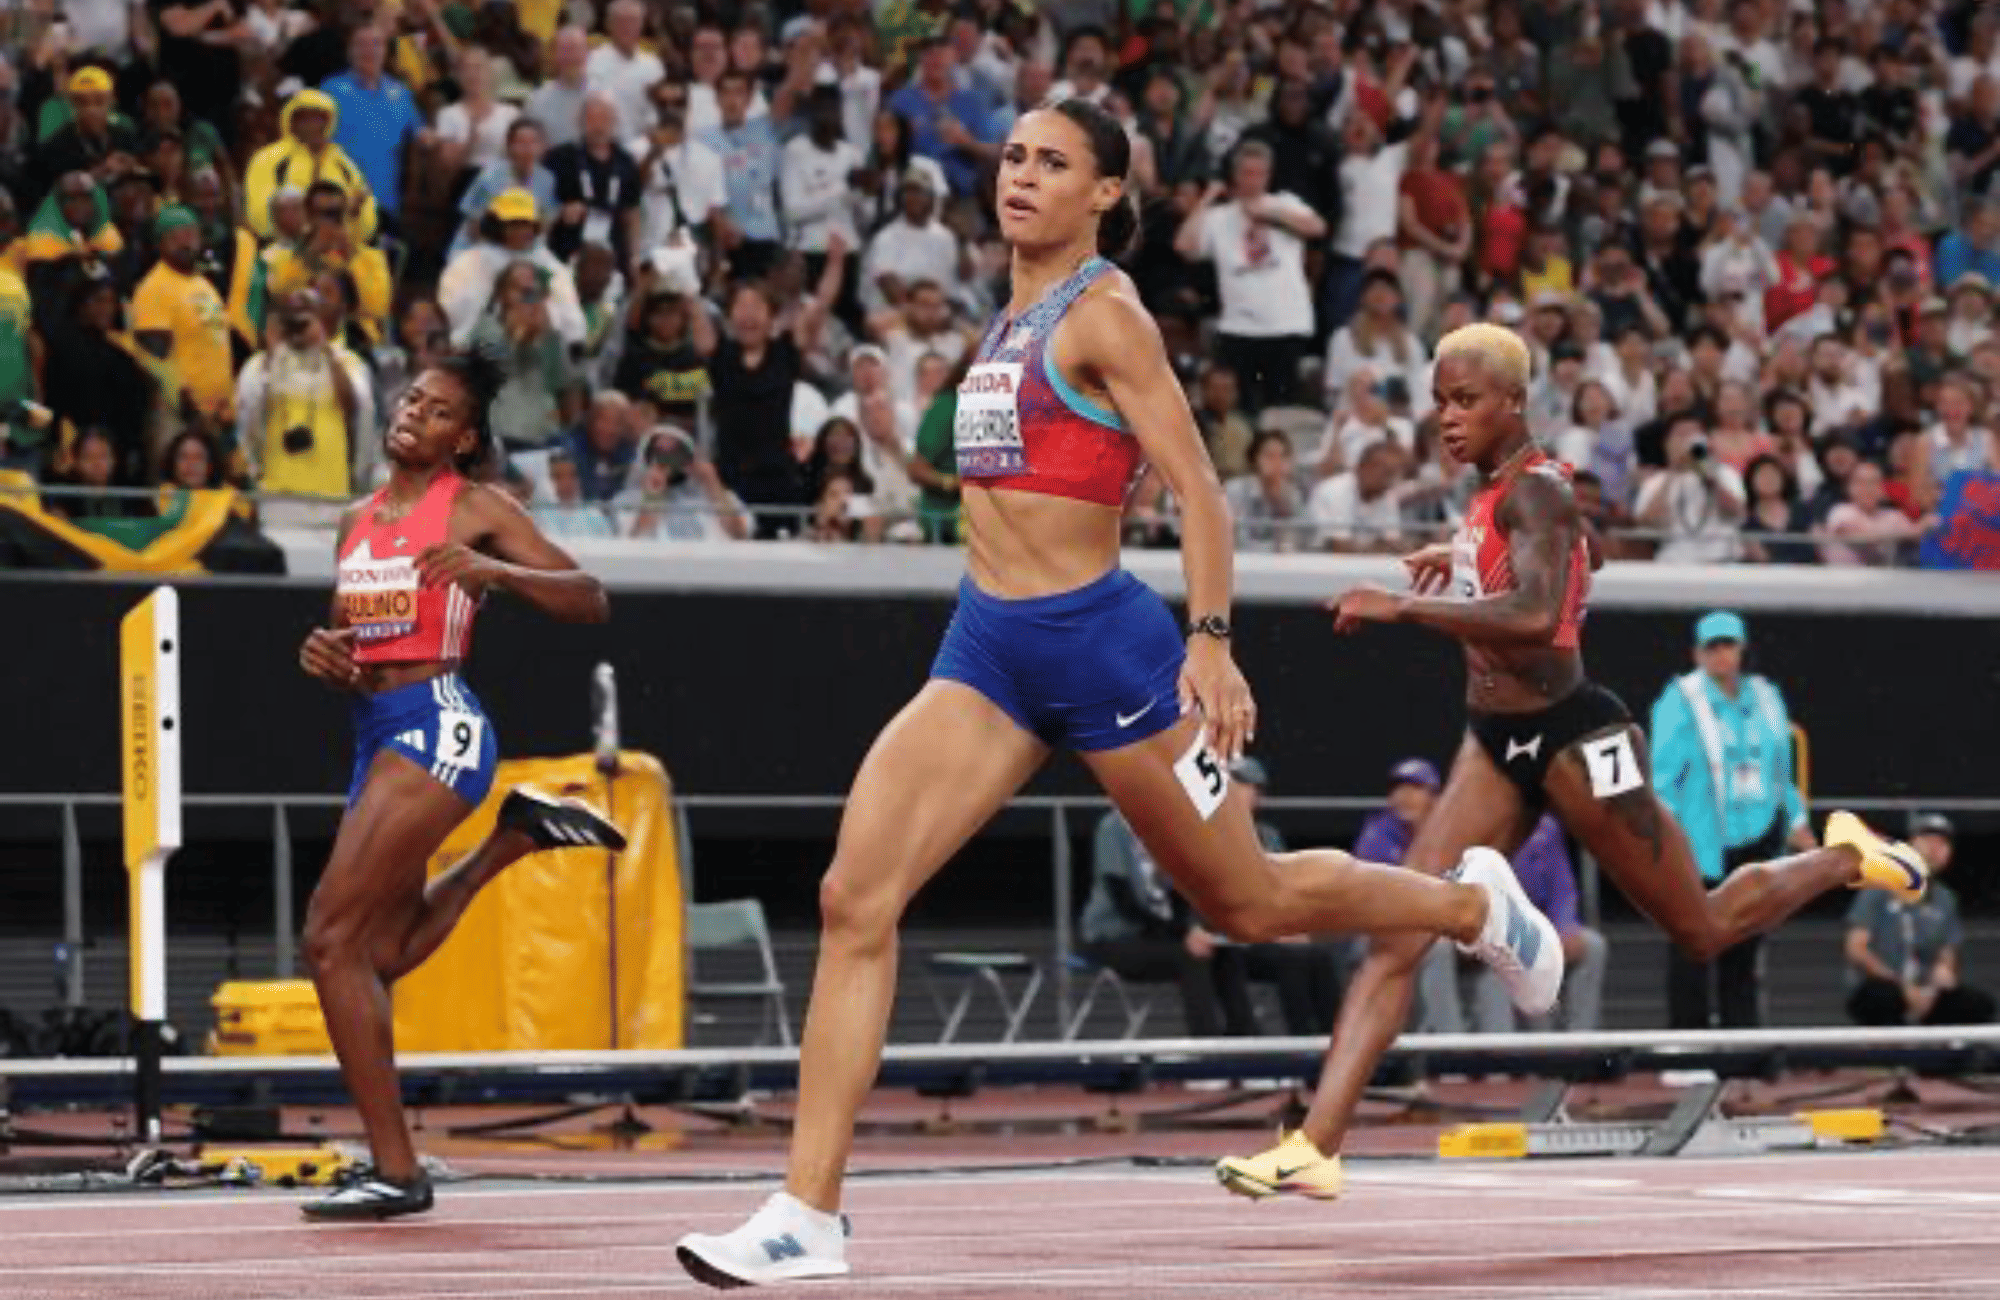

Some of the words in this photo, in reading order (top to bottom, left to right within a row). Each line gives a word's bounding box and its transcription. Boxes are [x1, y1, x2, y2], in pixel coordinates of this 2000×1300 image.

[452, 721, 472, 758] 9
[1196, 748, 1222, 797] 5
[1599, 745, 1620, 785] 7
